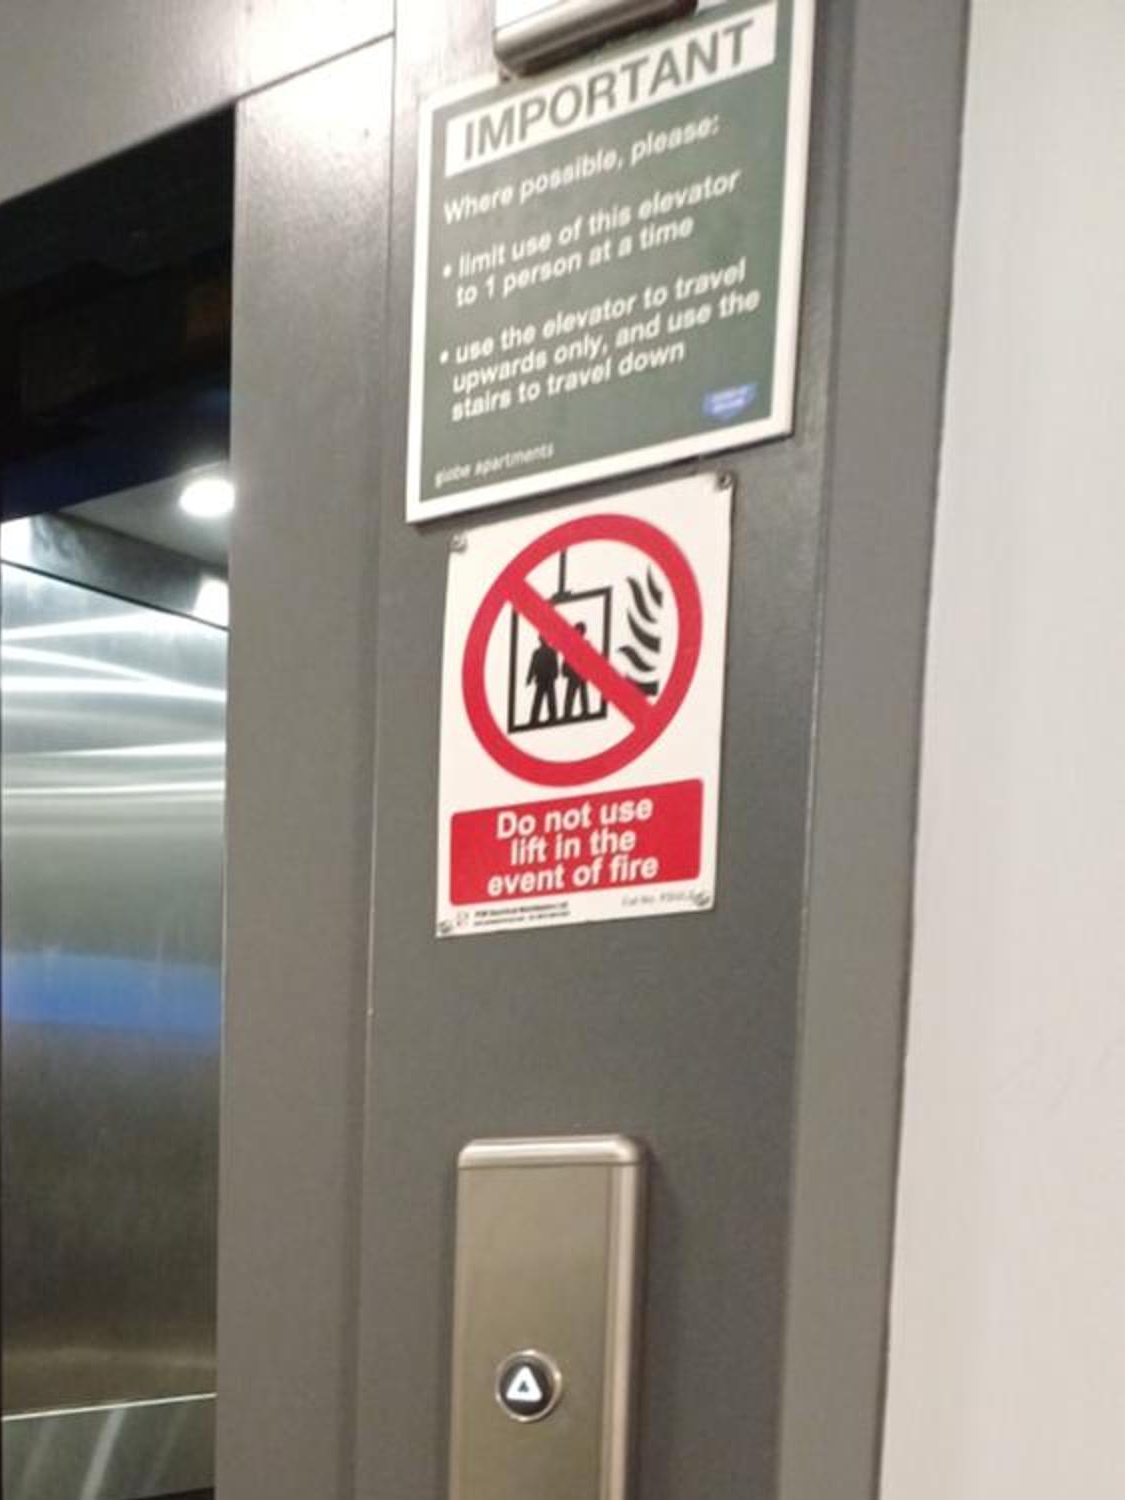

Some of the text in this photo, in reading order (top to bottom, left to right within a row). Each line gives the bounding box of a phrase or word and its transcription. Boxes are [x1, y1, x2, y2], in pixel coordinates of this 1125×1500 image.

[464, 18, 756, 162] IMPORTANT
[444, 115, 719, 224] Where possible, please:
[457, 216, 694, 307] to 1 person at a time
[459, 169, 741, 277] limit use of this elevator
[452, 290, 761, 393] upwards only, and use the
[456, 257, 746, 363] use the elevator to travel
[451, 342, 685, 422] stairs to travel down
[475, 442, 554, 480] apartments
[496, 797, 653, 840] Do not use
[510, 829, 636, 866] lift in the
[487, 855, 659, 897] event of fire
